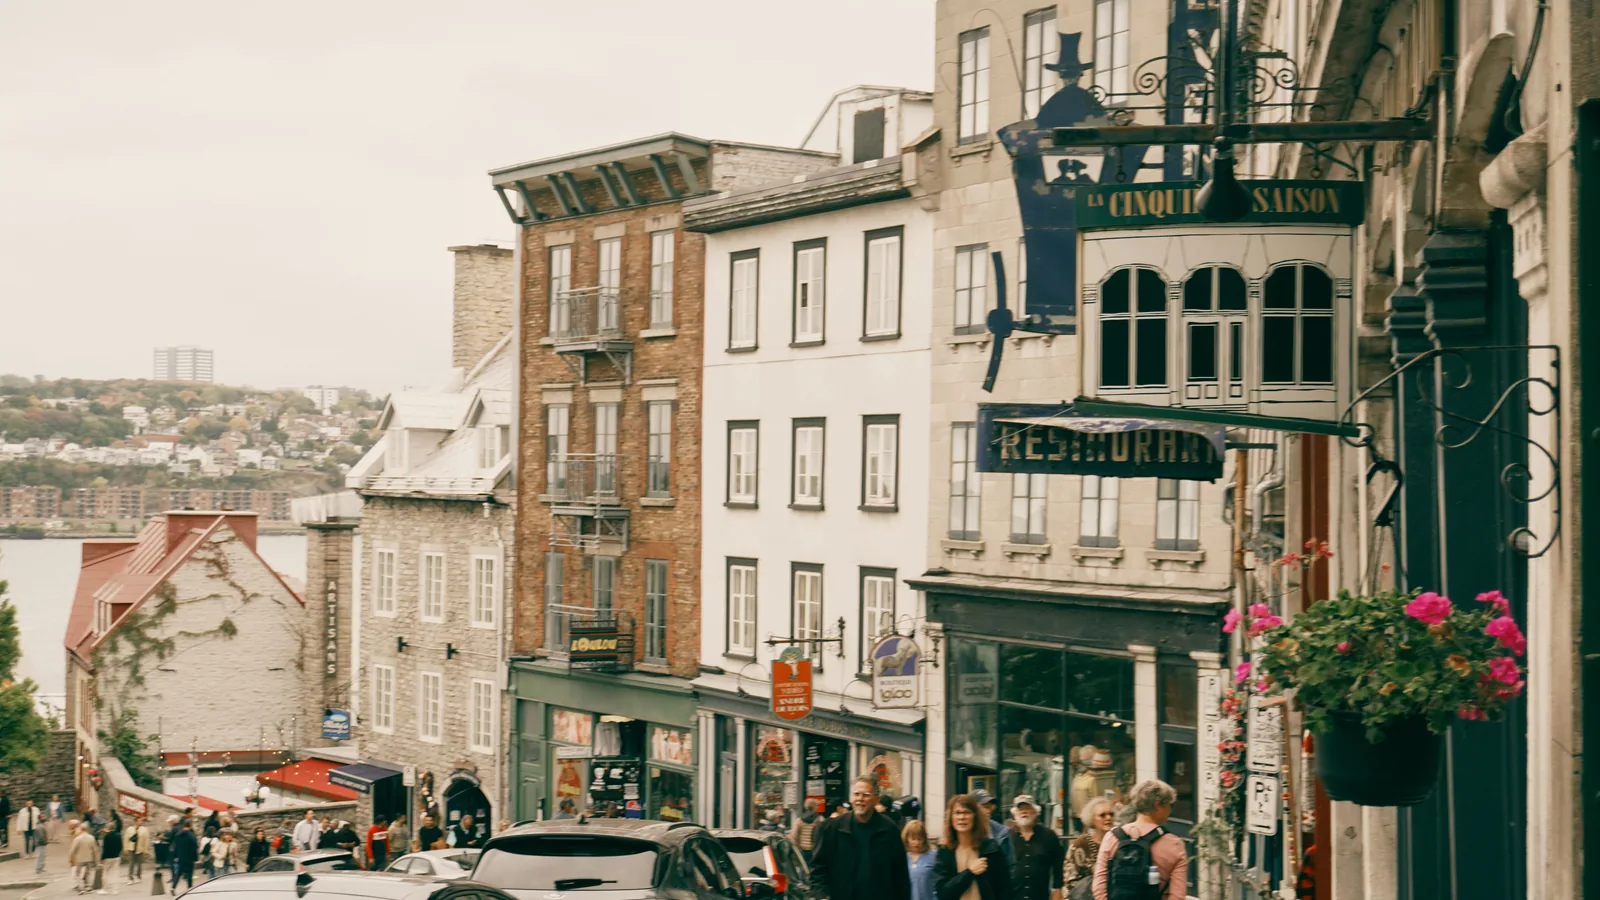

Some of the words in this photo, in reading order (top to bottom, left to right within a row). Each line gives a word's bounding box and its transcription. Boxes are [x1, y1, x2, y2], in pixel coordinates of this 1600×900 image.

[1088, 193, 1104, 207] LA
[1252, 187, 1340, 214] SAISON
[327, 581, 337, 674] ARTISANS
